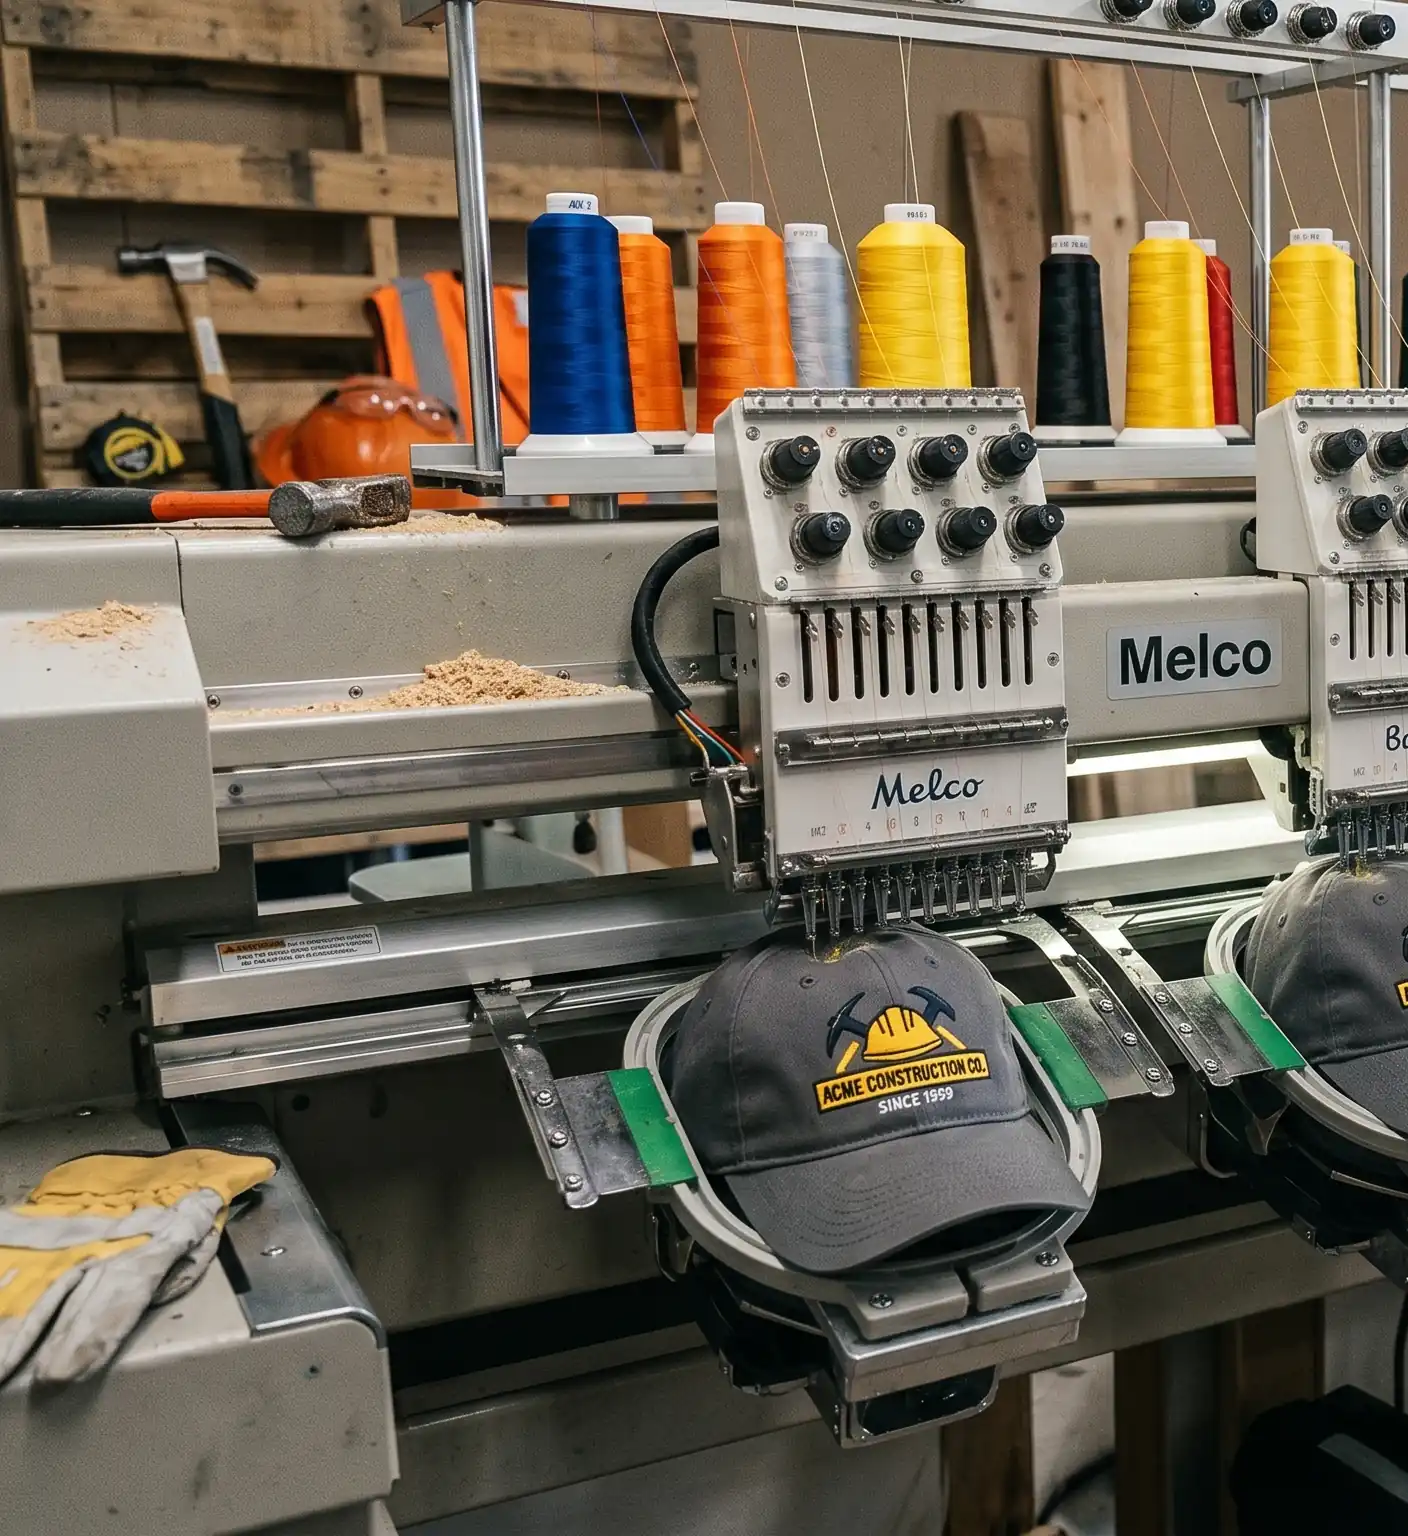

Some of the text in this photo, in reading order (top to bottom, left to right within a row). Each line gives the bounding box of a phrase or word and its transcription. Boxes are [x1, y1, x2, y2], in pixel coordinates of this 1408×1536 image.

[1120, 632, 1272, 686] Melco
[871, 768, 985, 810] Melco
[823, 1056, 986, 1105] ACME CONSTRUCTION CO.
[878, 1092, 921, 1115] SINCE
